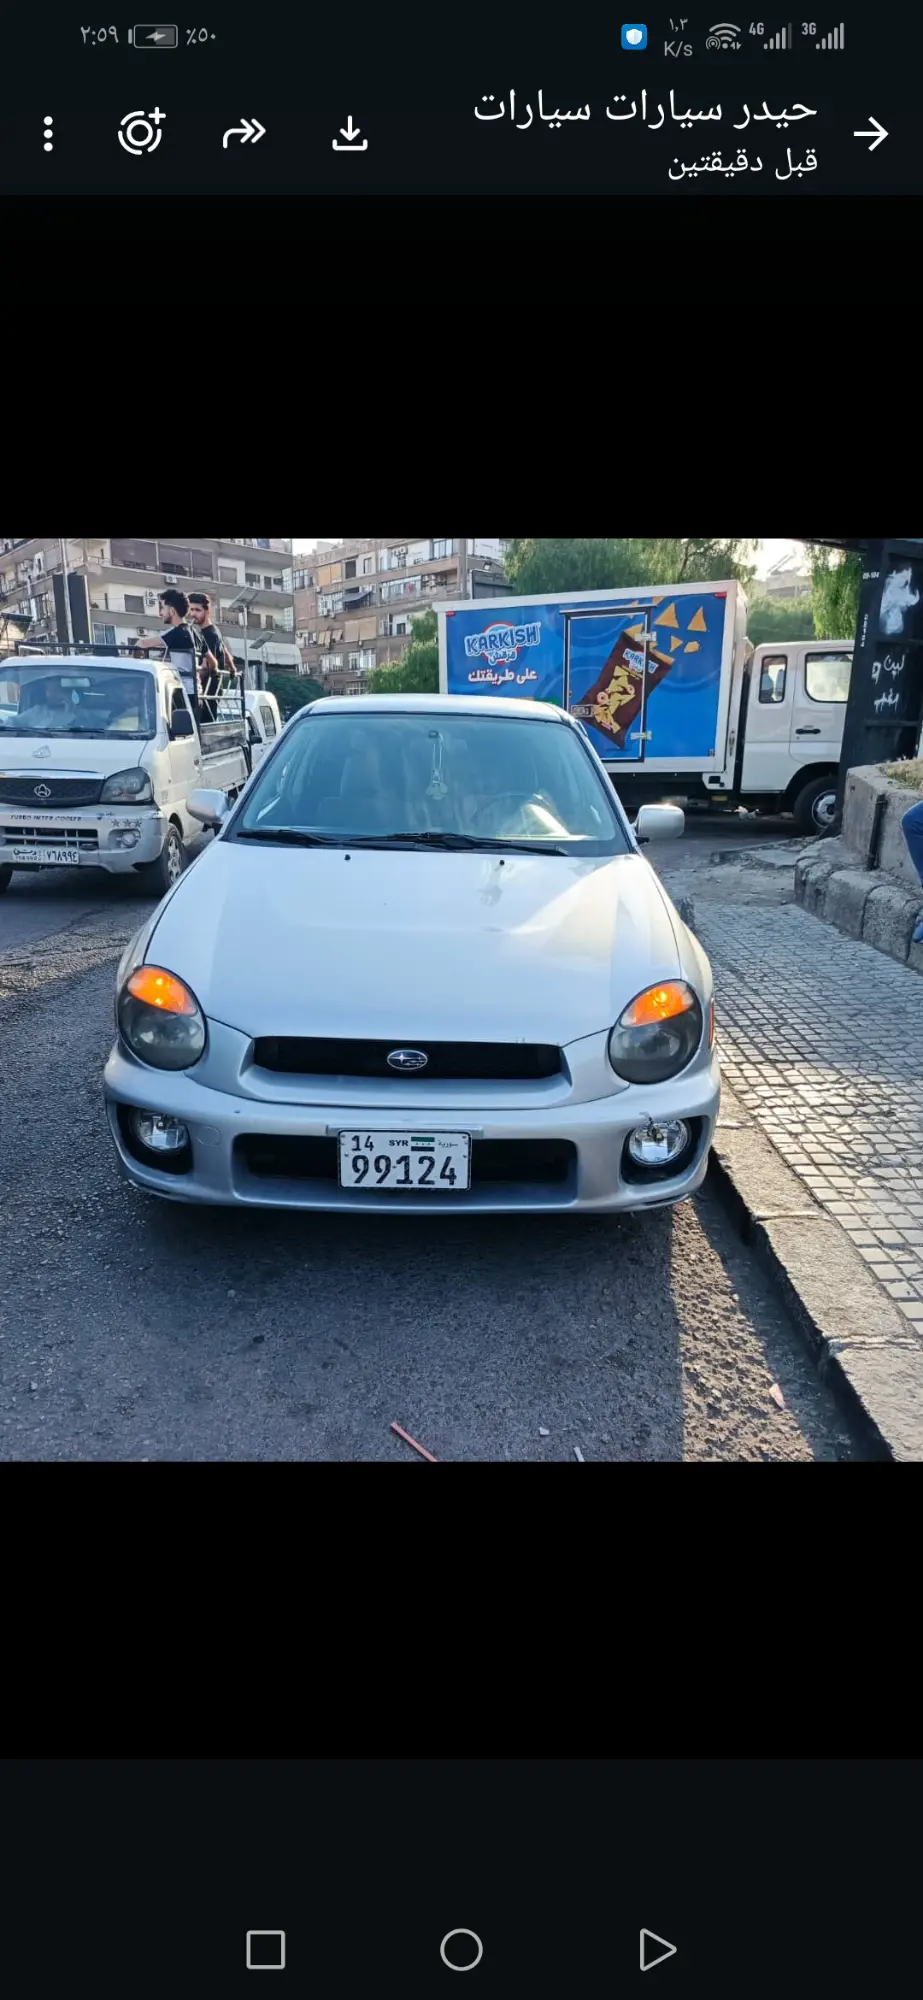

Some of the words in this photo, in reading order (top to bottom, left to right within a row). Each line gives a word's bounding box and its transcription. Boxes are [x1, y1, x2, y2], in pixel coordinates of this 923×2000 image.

[465, 624, 540, 655] KARKISH
[468, 669, 515, 685] طريقتك
[517, 668, 538, 684] على
[351, 1135, 374, 1151] 14
[389, 1139, 409, 1147] SYR
[352, 1155, 457, 1186] 99124
